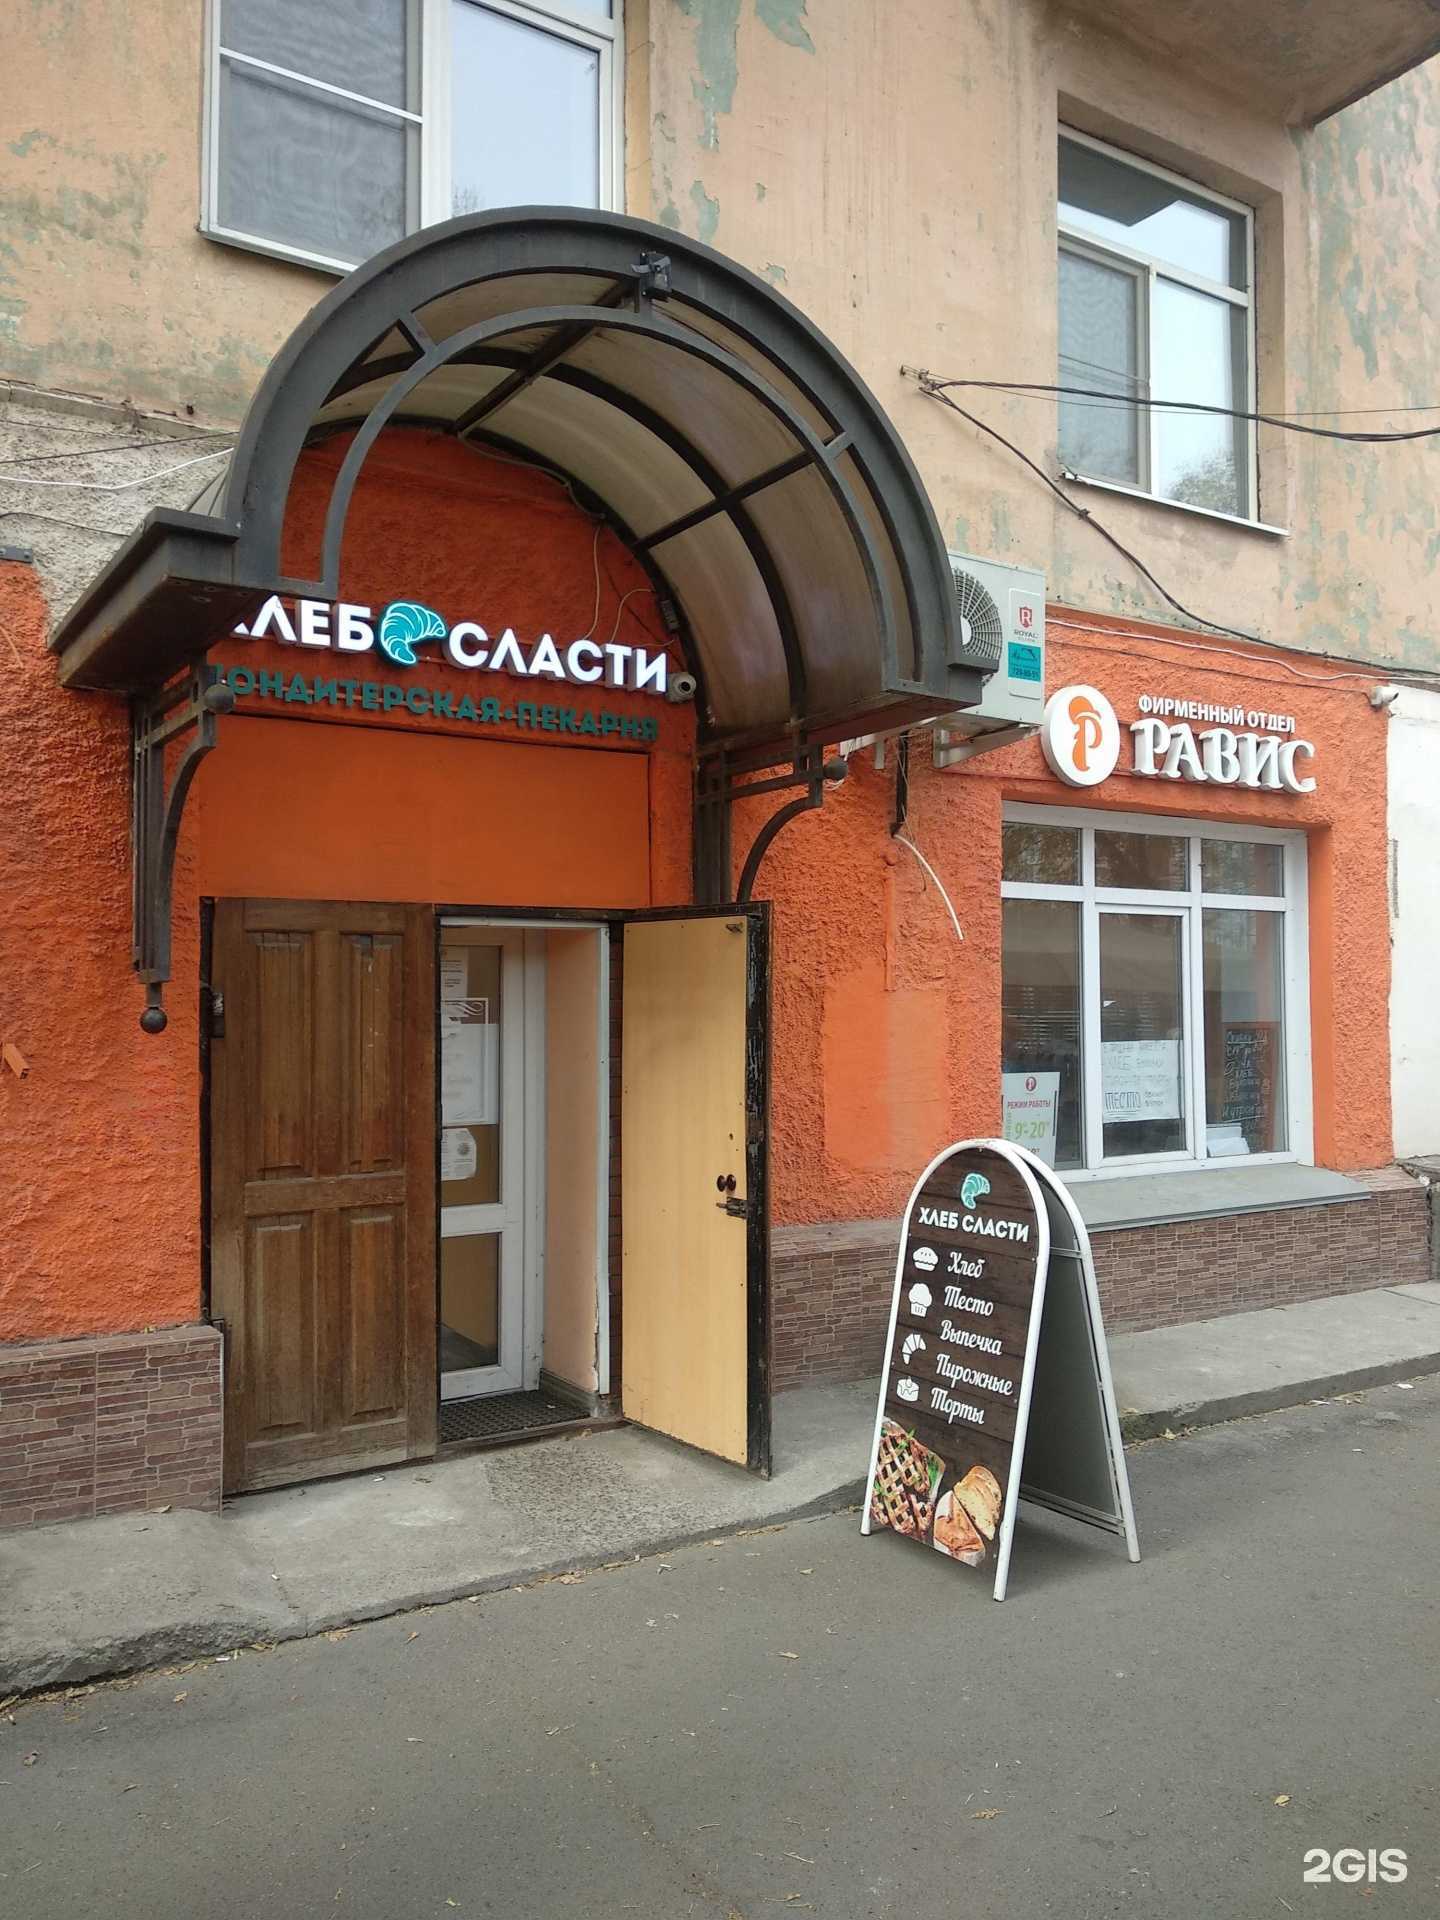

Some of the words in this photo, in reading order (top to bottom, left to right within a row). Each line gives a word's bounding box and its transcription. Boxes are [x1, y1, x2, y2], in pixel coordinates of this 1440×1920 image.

[232, 594, 375, 652] ЛЕБ
[448, 622, 667, 694] СЛАСТИ
[214, 662, 501, 725] ОНДИТЕРСКАЯ
[1138, 694, 1244, 726] ФИРМЕННЫЙ
[1247, 710, 1296, 734] ОТДЕЛ
[1130, 717, 1317, 794] РАВИС
[918, 1207, 959, 1230] ХЛЕБ
[962, 1214, 1030, 1243] СЛАСТИ
[947, 1252, 985, 1278] Хлеб
[943, 1285, 994, 1317] Тесто
[940, 1319, 1003, 1356] Выпечка
[935, 1352, 1013, 1397] Пирожные
[930, 1387, 985, 1425] Торты
